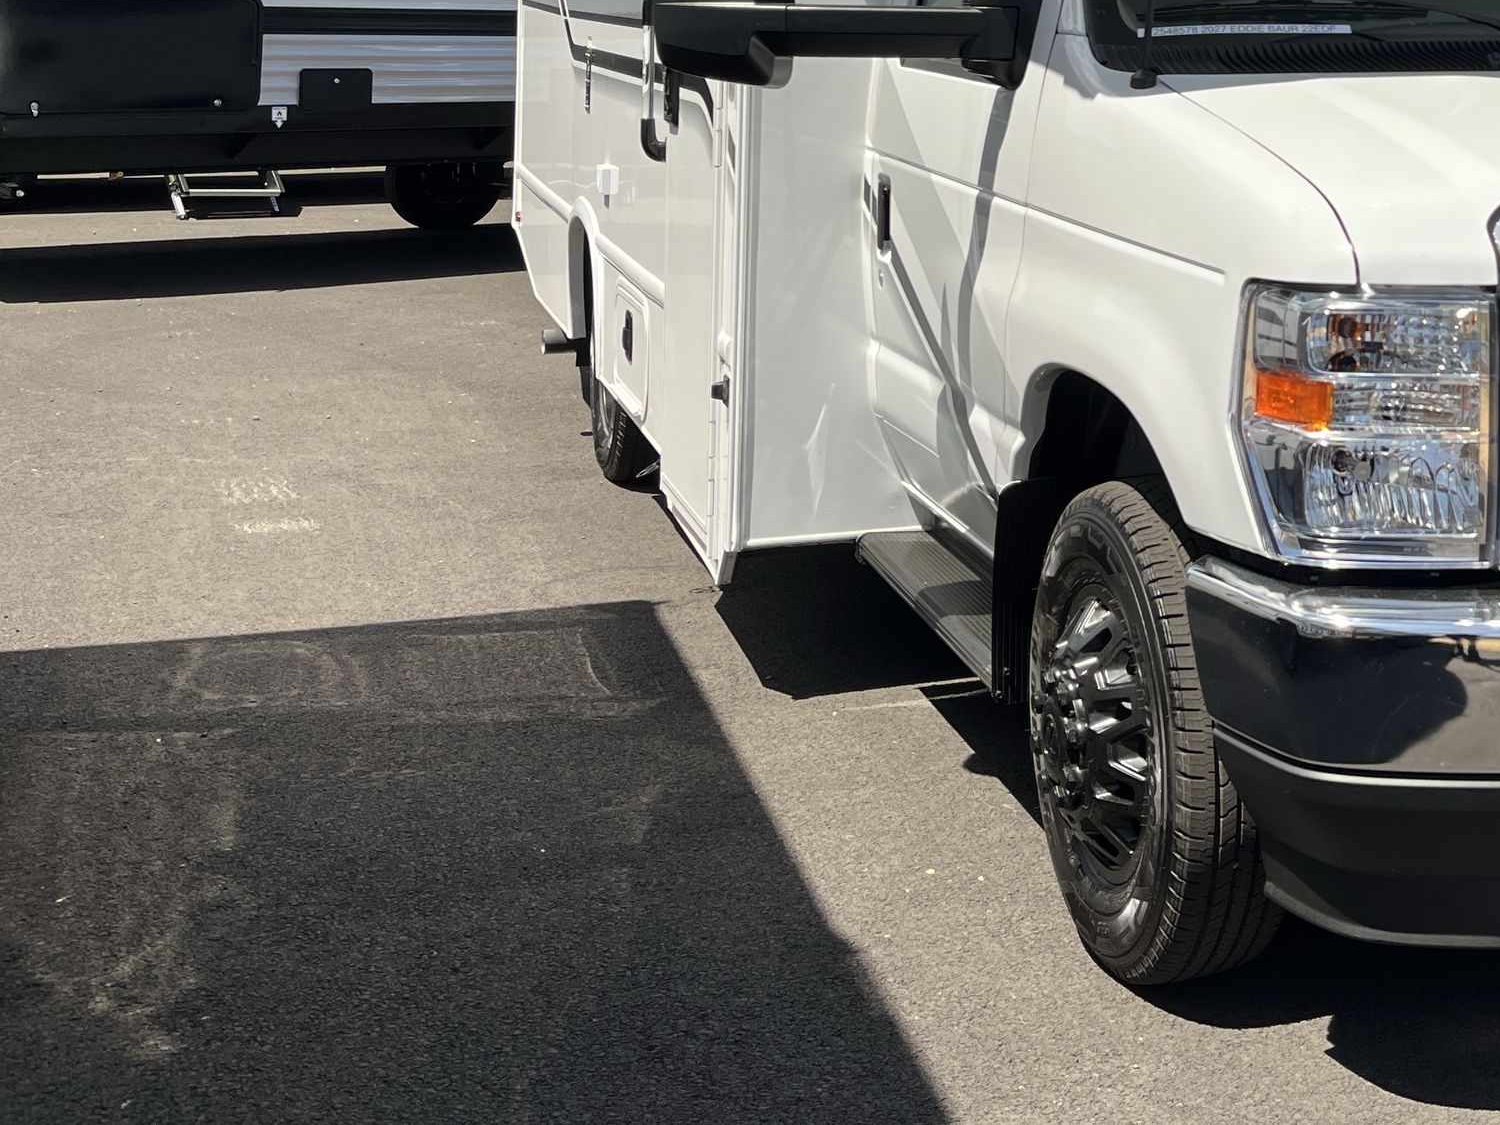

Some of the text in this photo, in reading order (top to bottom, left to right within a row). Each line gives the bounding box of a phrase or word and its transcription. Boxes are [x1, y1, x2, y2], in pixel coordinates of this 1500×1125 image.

[1200, 25, 1226, 34] 2027
[1230, 24, 1264, 34] EDDIE
[1267, 24, 1299, 34] BAUR
